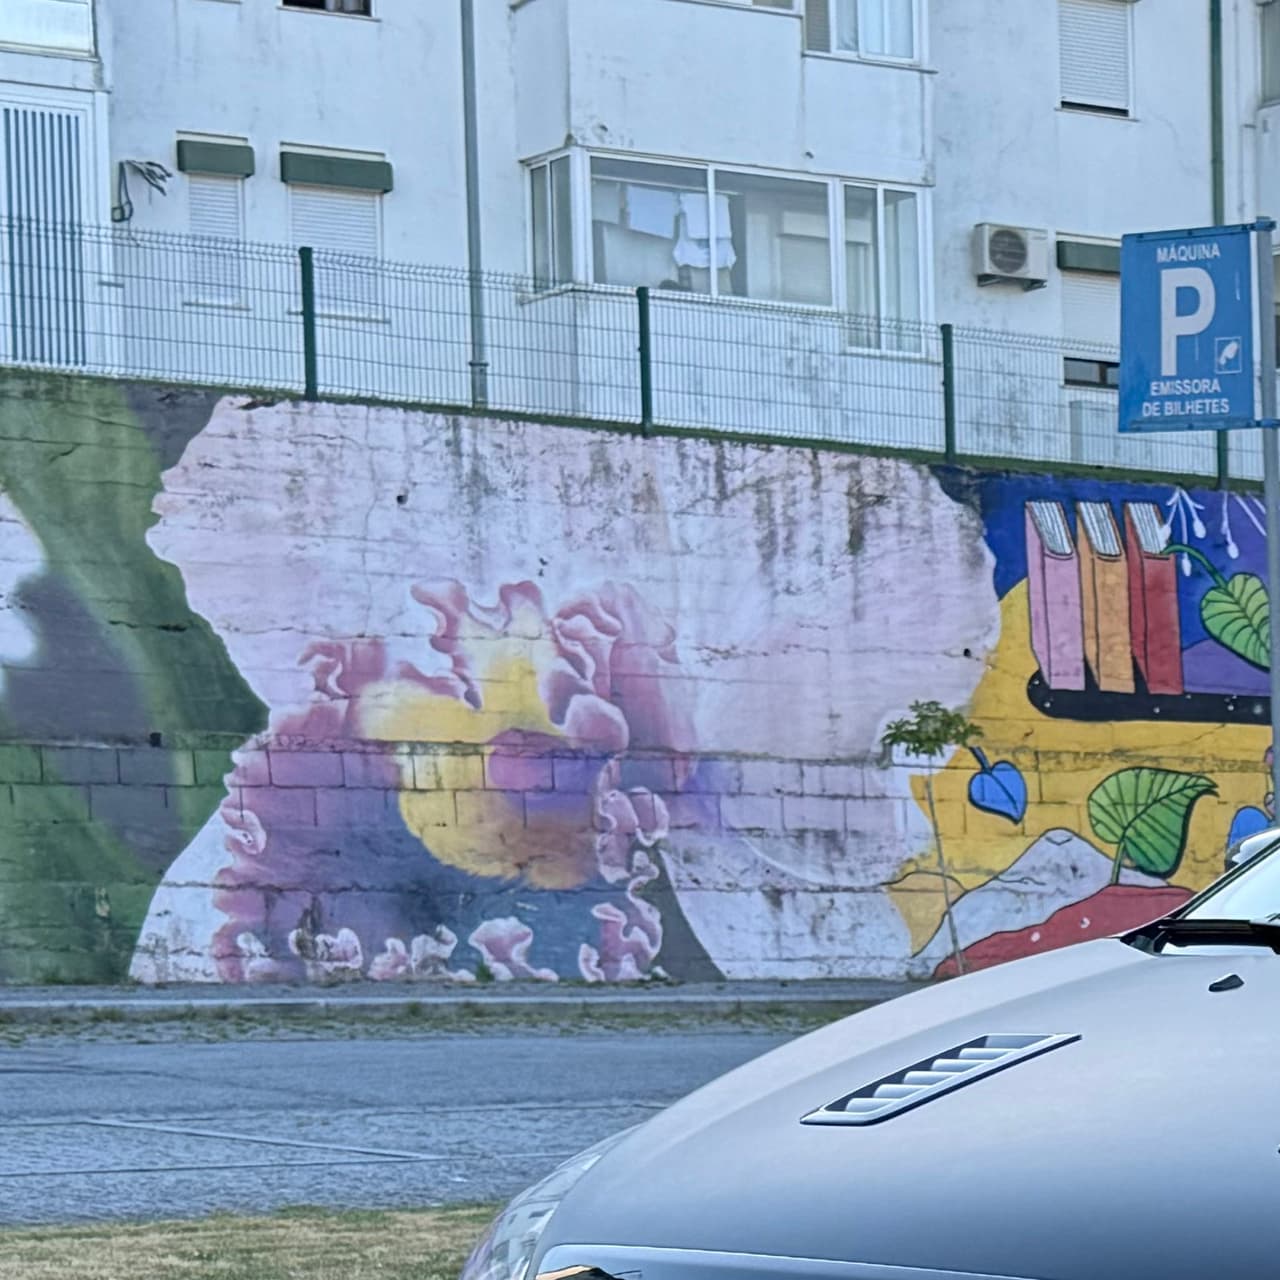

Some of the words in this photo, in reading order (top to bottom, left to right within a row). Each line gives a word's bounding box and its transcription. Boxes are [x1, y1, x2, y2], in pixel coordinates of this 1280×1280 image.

[1157, 243, 1221, 262] MÁQUINA
[1161, 267, 1216, 376] P
[1151, 379, 1221, 396] EMISSORA
[1142, 402, 1160, 416] DE
[1164, 399, 1230, 416] BILHETES
